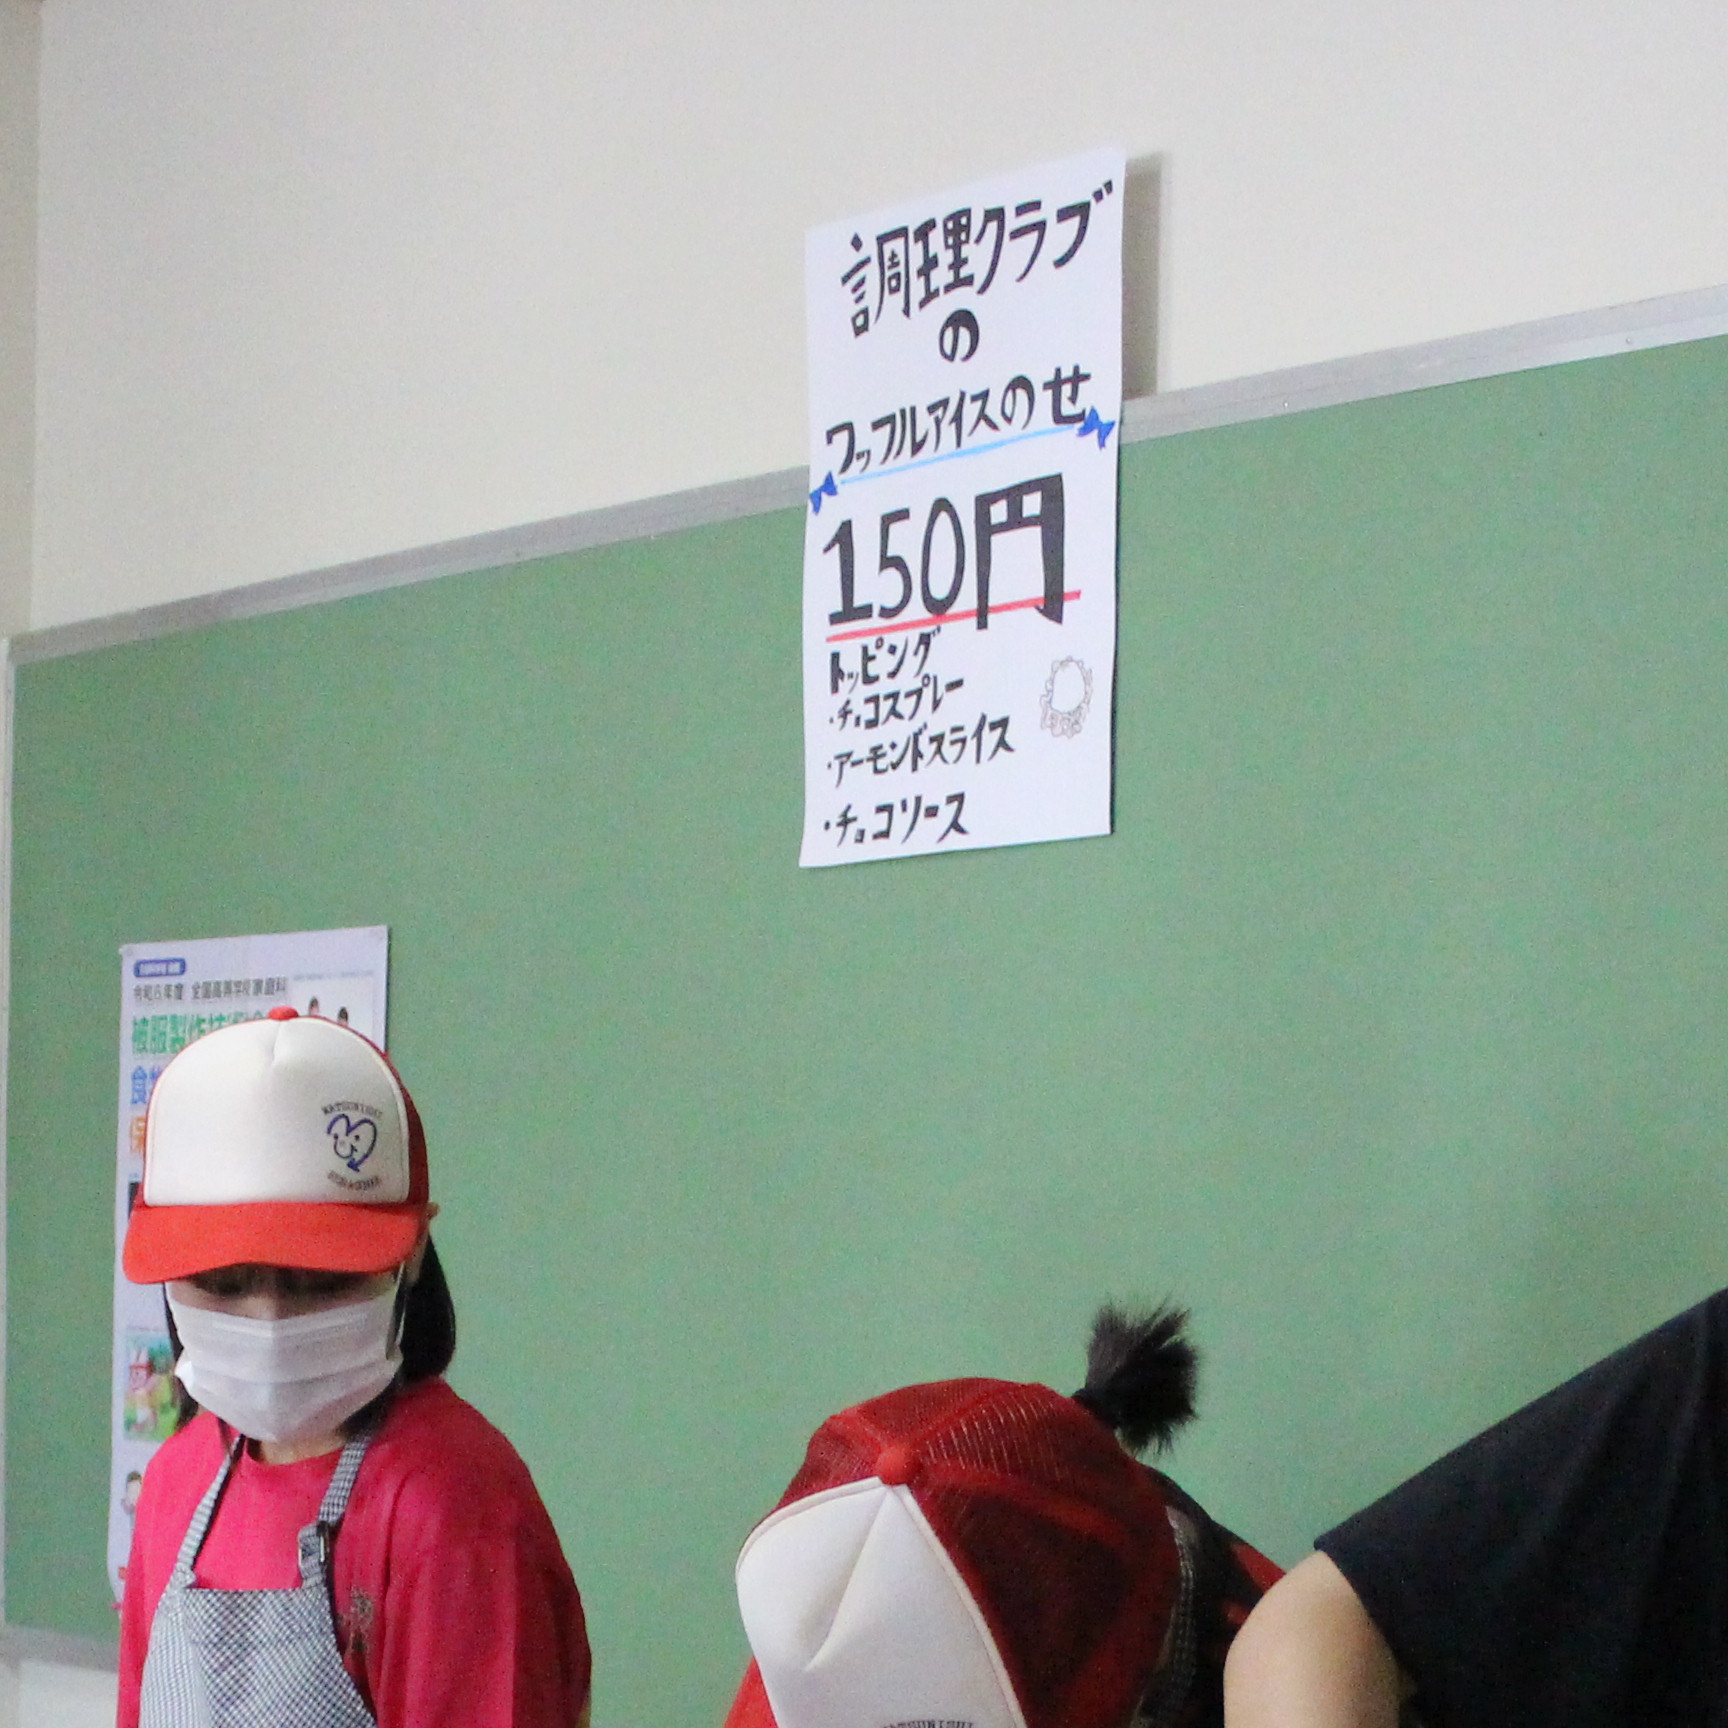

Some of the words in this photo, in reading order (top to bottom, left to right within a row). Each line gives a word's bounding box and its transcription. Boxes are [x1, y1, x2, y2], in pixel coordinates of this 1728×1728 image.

[841, 179, 1114, 338] 調理クラブ
[939, 308, 980, 362] の
[826, 364, 1091, 475] ワッフルアイスのせ
[823, 473, 1065, 630] 150円
[829, 626, 942, 696] トッピング
